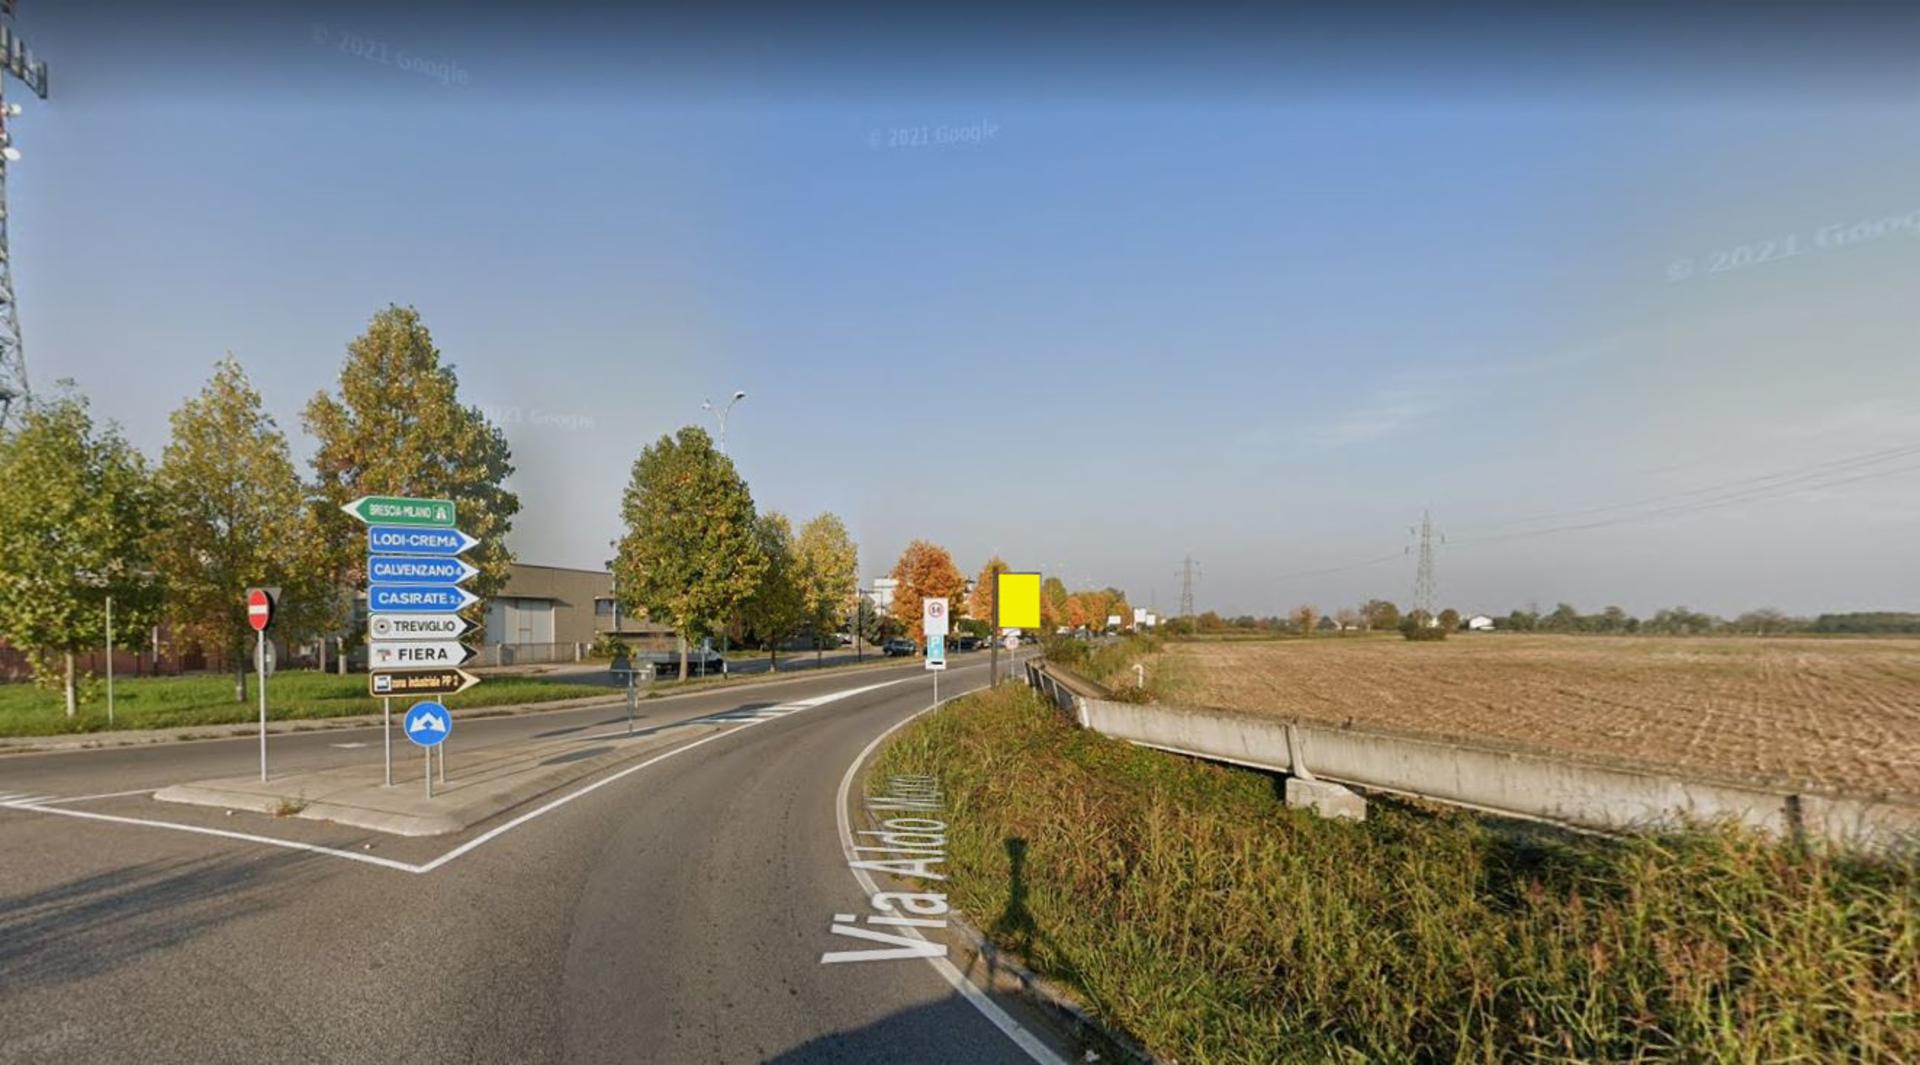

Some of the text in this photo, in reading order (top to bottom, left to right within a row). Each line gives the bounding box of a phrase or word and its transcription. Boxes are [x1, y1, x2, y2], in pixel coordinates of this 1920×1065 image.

[369, 503, 432, 518] BRESCIA-MILANO
[372, 533, 459, 548] LODI-CREMA
[373, 563, 454, 577] CALVENZANO
[378, 591, 448, 605] CASIRATE
[393, 620, 456, 632] TREVIGLIO
[398, 648, 448, 660] FIERA
